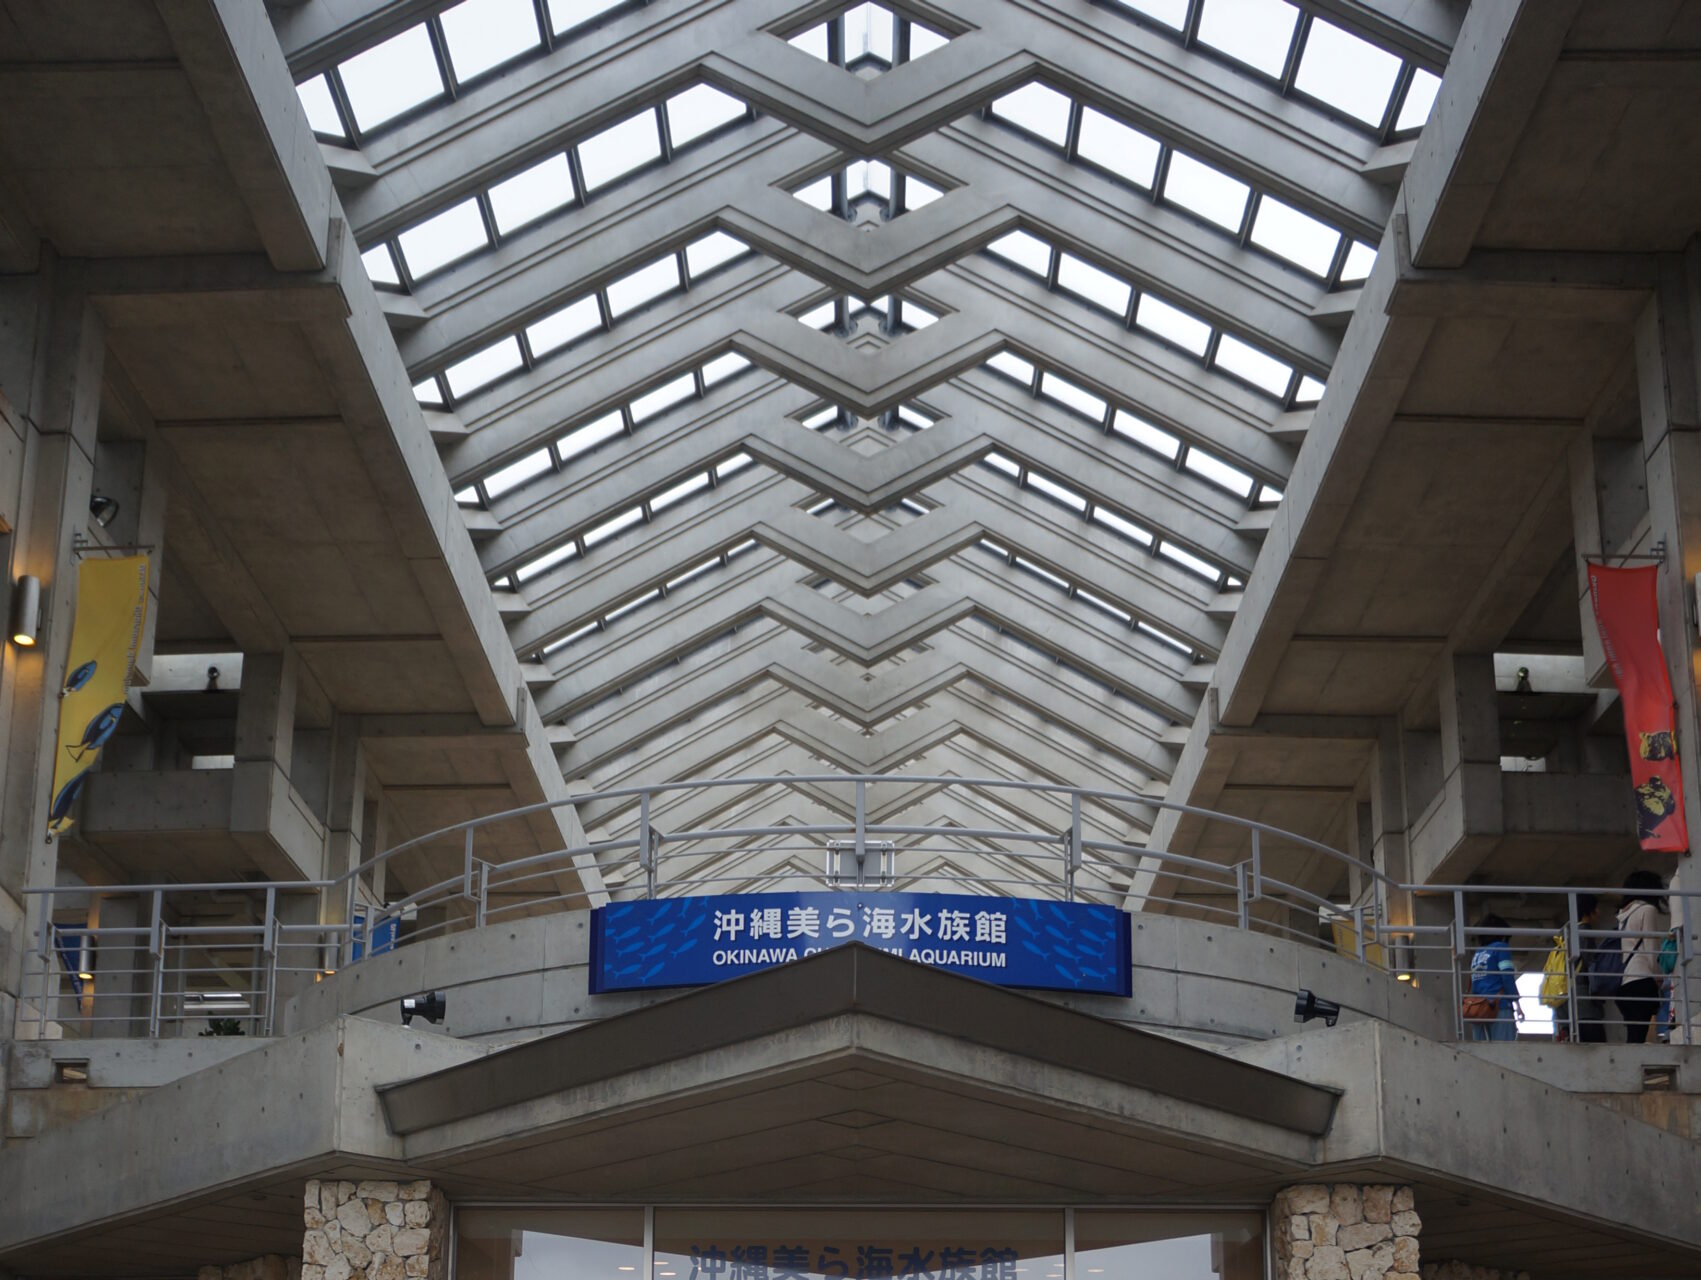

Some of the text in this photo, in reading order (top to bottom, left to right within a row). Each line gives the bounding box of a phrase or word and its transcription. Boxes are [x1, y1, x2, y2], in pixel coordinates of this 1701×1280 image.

[713, 906, 1007, 944] 沖縄美ら海水族館
[712, 947, 798, 966] OKINAWA
[909, 947, 1006, 968] AQUARIUM
